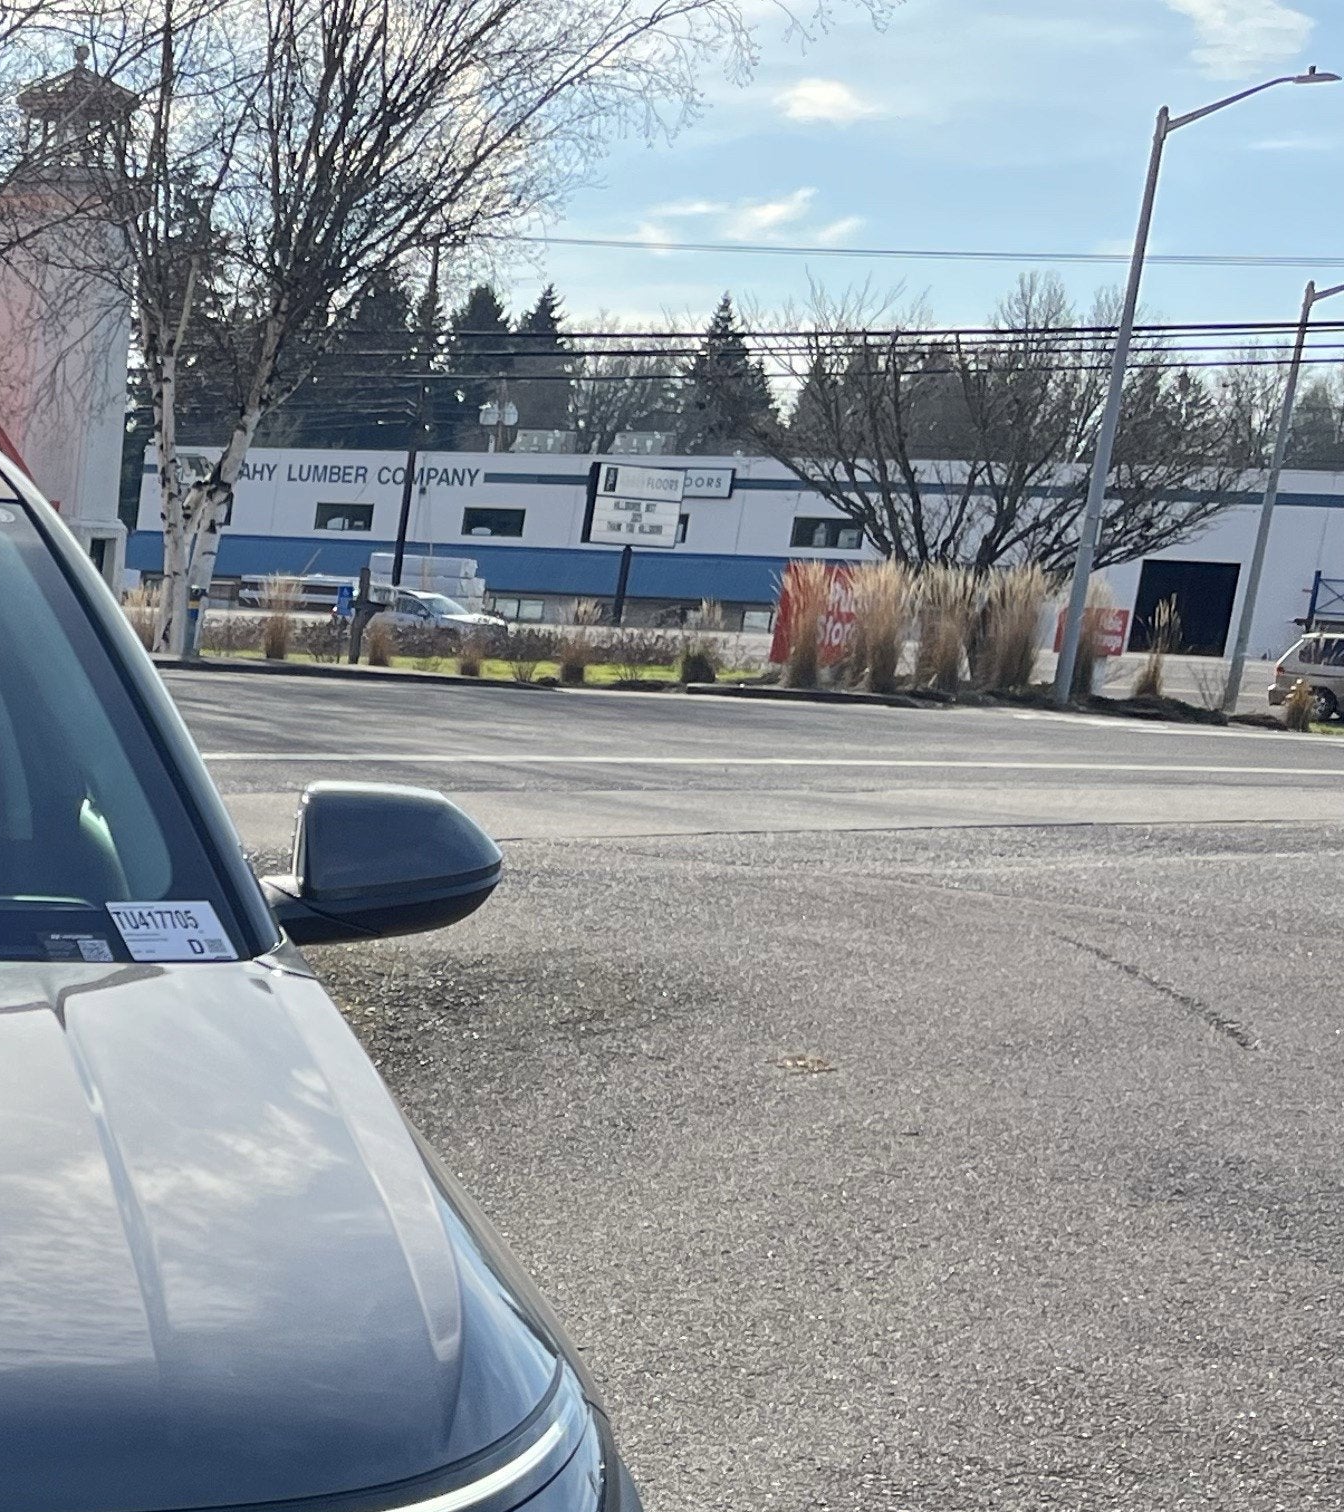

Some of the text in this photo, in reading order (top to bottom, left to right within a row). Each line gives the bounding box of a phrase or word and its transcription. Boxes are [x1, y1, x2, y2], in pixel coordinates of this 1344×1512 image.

[238, 462, 480, 487] AHY LUMBER COMPANY
[684, 476, 722, 489] OORS
[112, 909, 200, 931] TU417705
